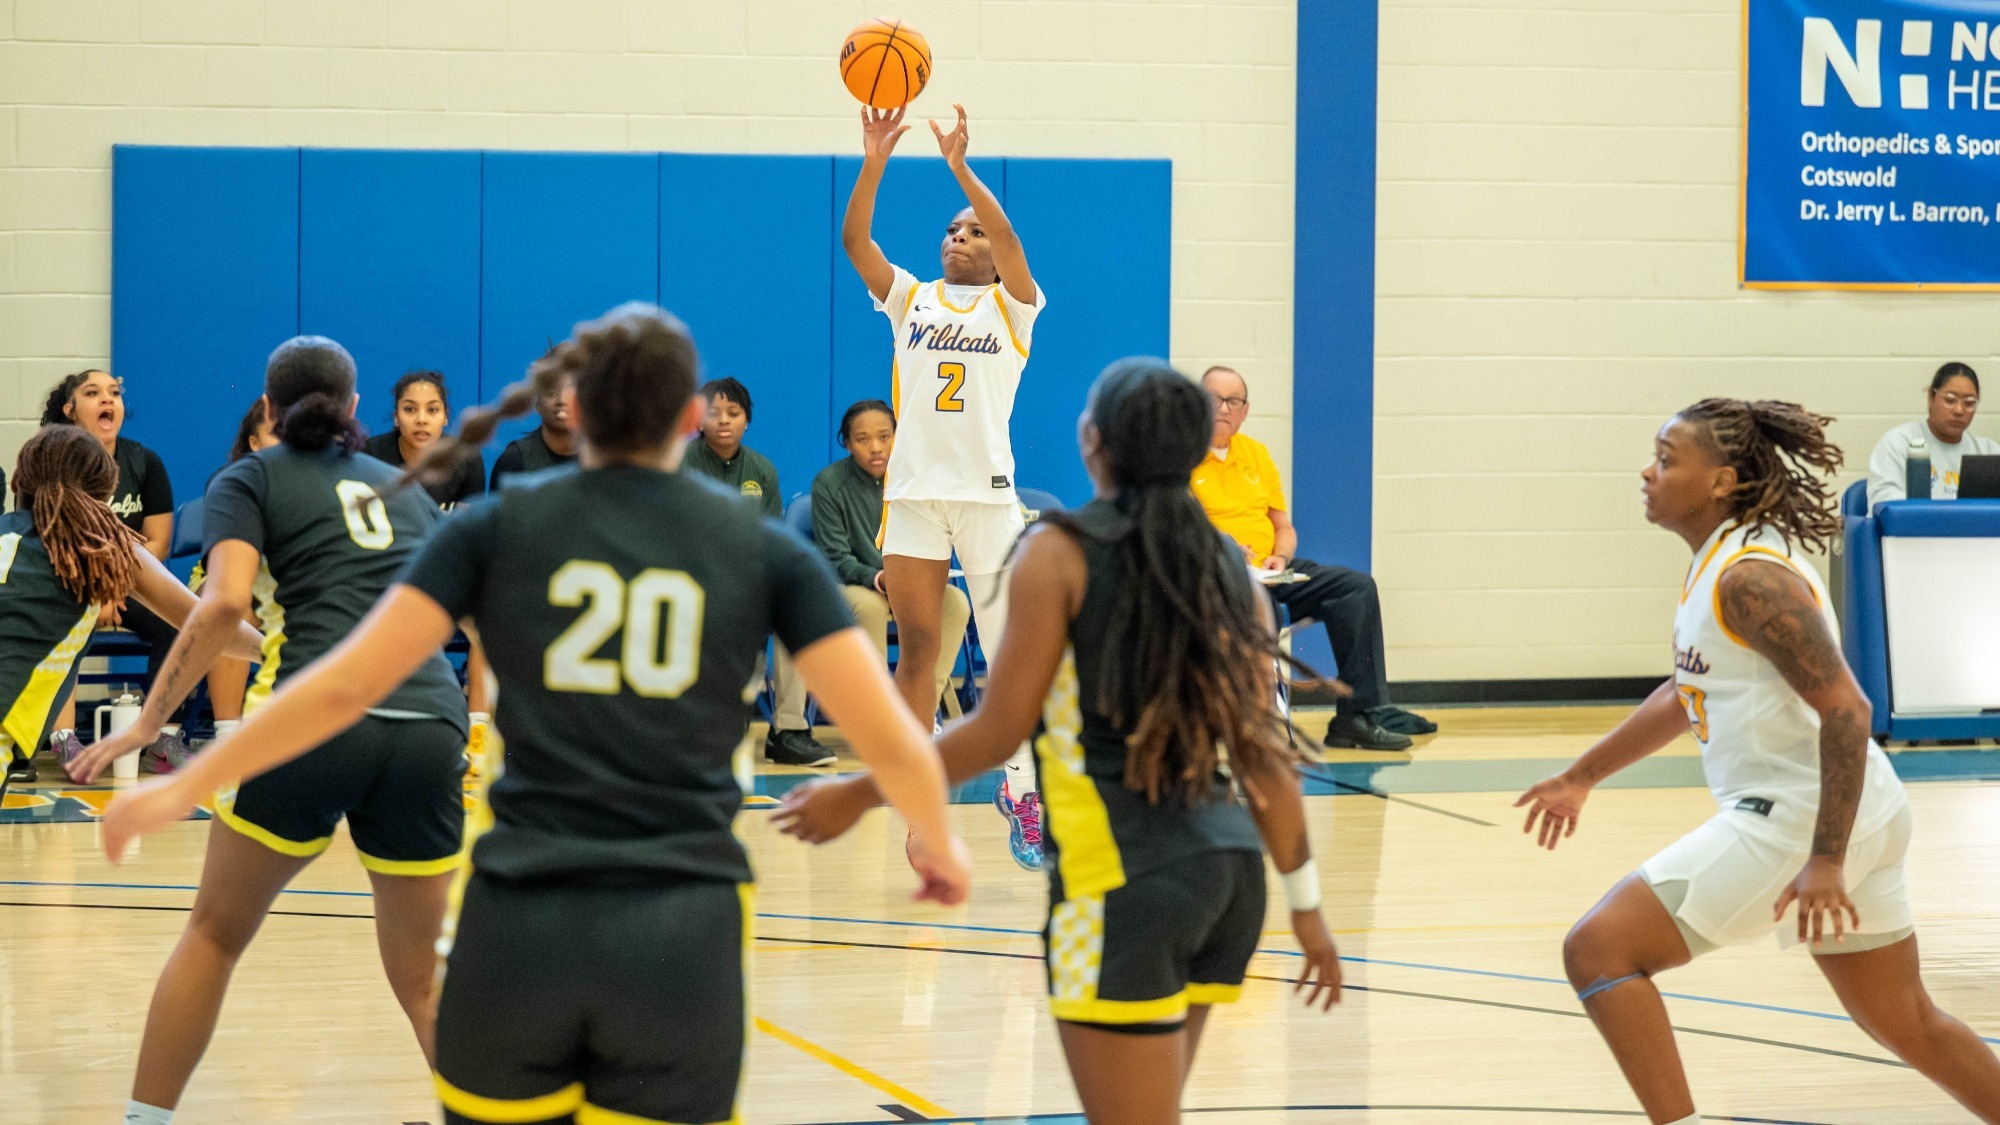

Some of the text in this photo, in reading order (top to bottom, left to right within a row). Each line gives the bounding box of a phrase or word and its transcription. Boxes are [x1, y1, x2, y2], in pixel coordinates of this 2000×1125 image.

[1801, 131, 1930, 157] Orthopedics
[1935, 133, 1952, 155] &
[1801, 165, 1897, 188] Cotswold
[1800, 199, 1830, 221] Dr.
[1834, 200, 1884, 226] Jerry
[1889, 201, 1906, 222] L.
[1912, 201, 1990, 226] Barron,
[907, 322, 1002, 354] Wildcats
[935, 361, 966, 412] 2
[335, 479, 394, 551] 0
[543, 559, 706, 699] 20
